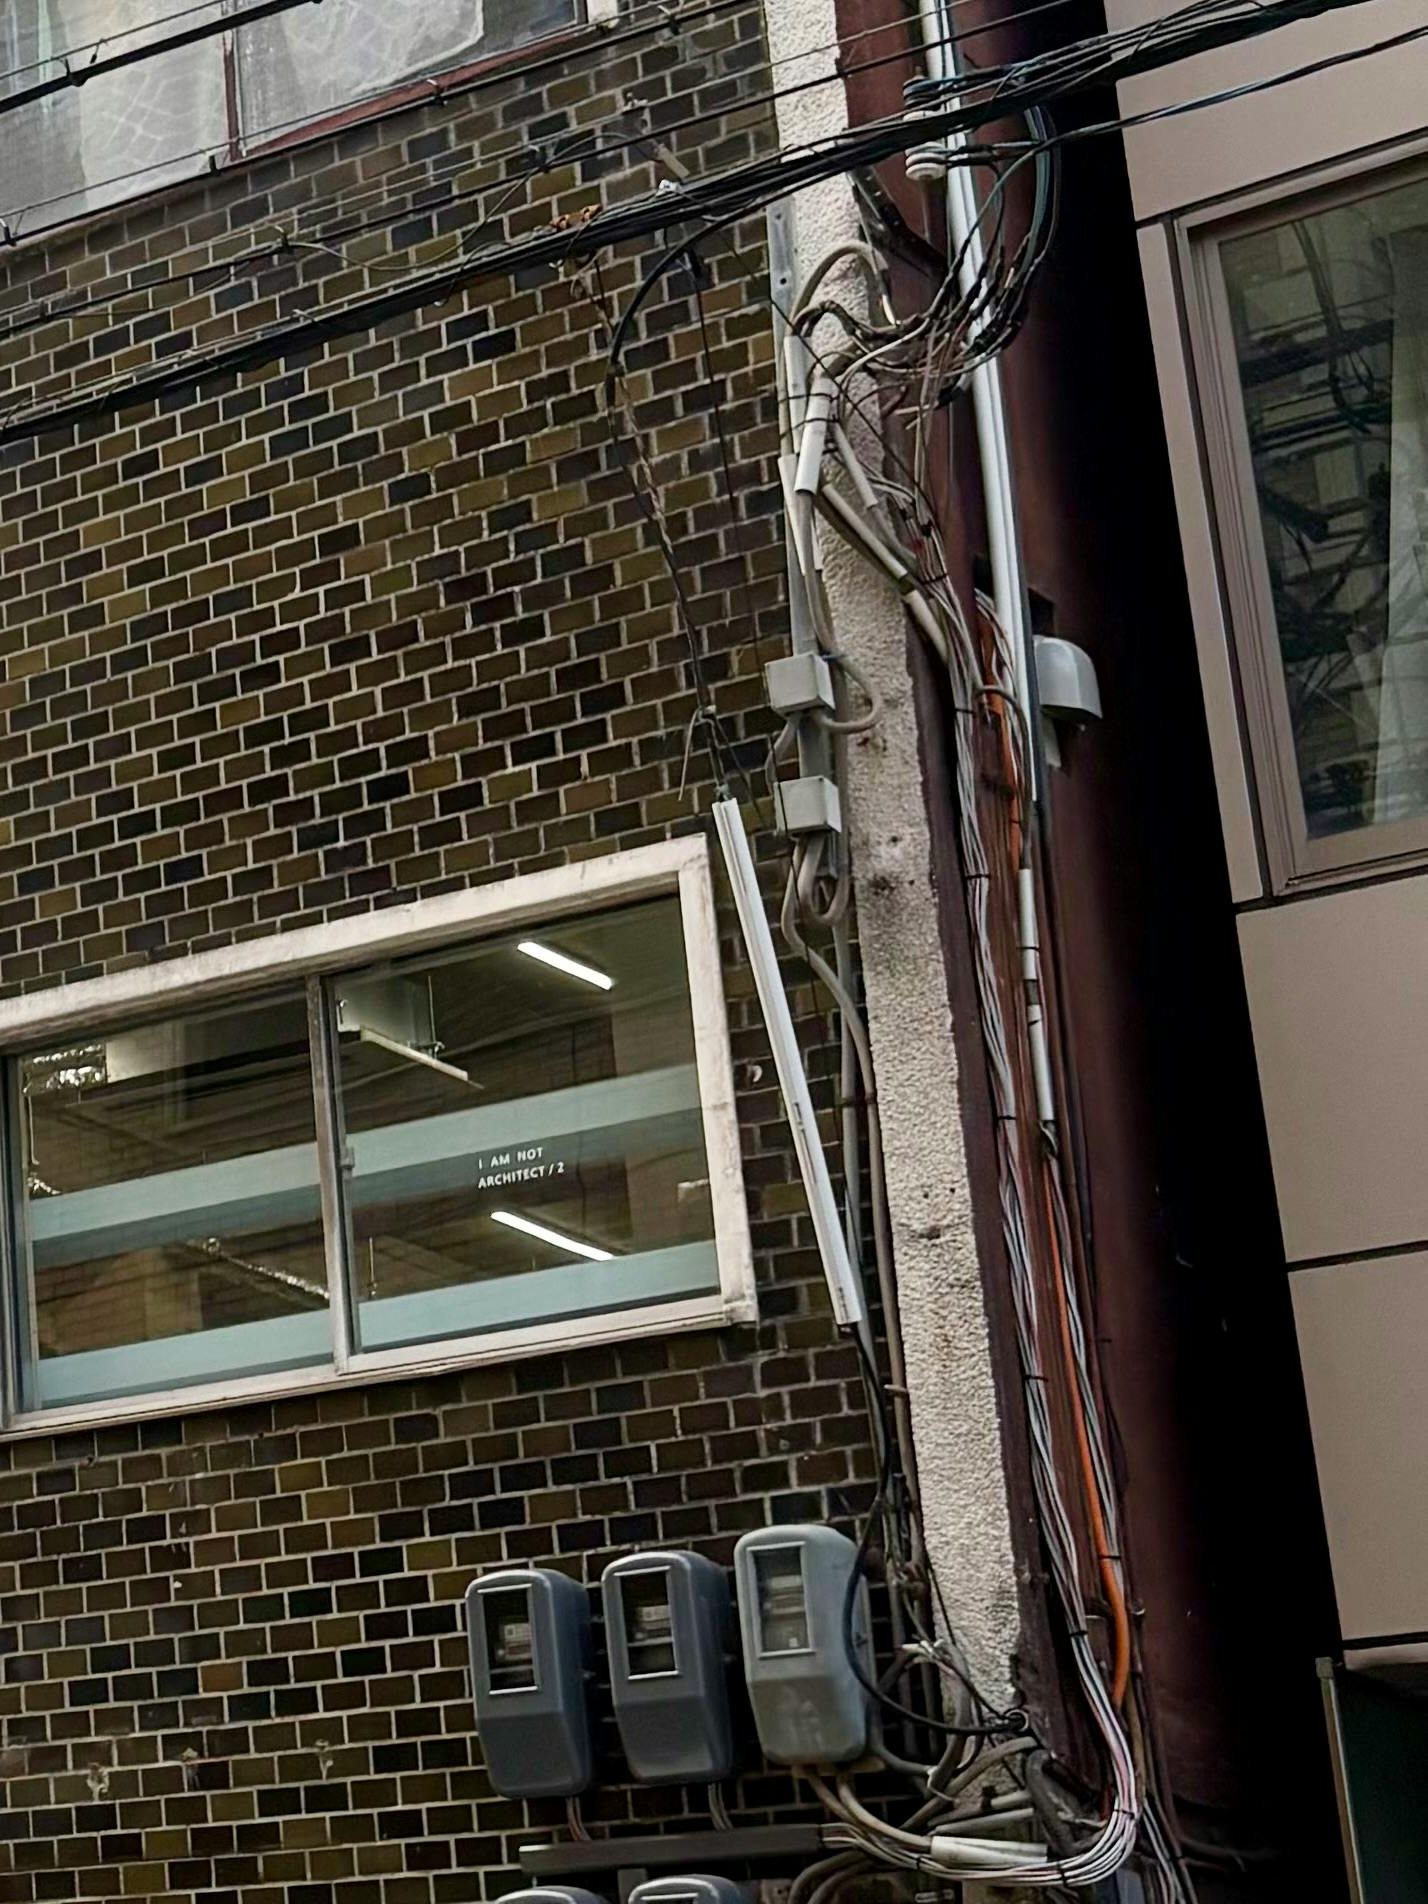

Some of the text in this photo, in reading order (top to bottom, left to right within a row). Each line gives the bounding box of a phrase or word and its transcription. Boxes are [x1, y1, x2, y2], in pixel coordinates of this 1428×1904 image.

[490, 1153, 510, 1168] AM
[517, 1147, 543, 1163] NOT
[478, 1164, 544, 1189] ARCHITECT
[557, 1161, 565, 1173] 2
